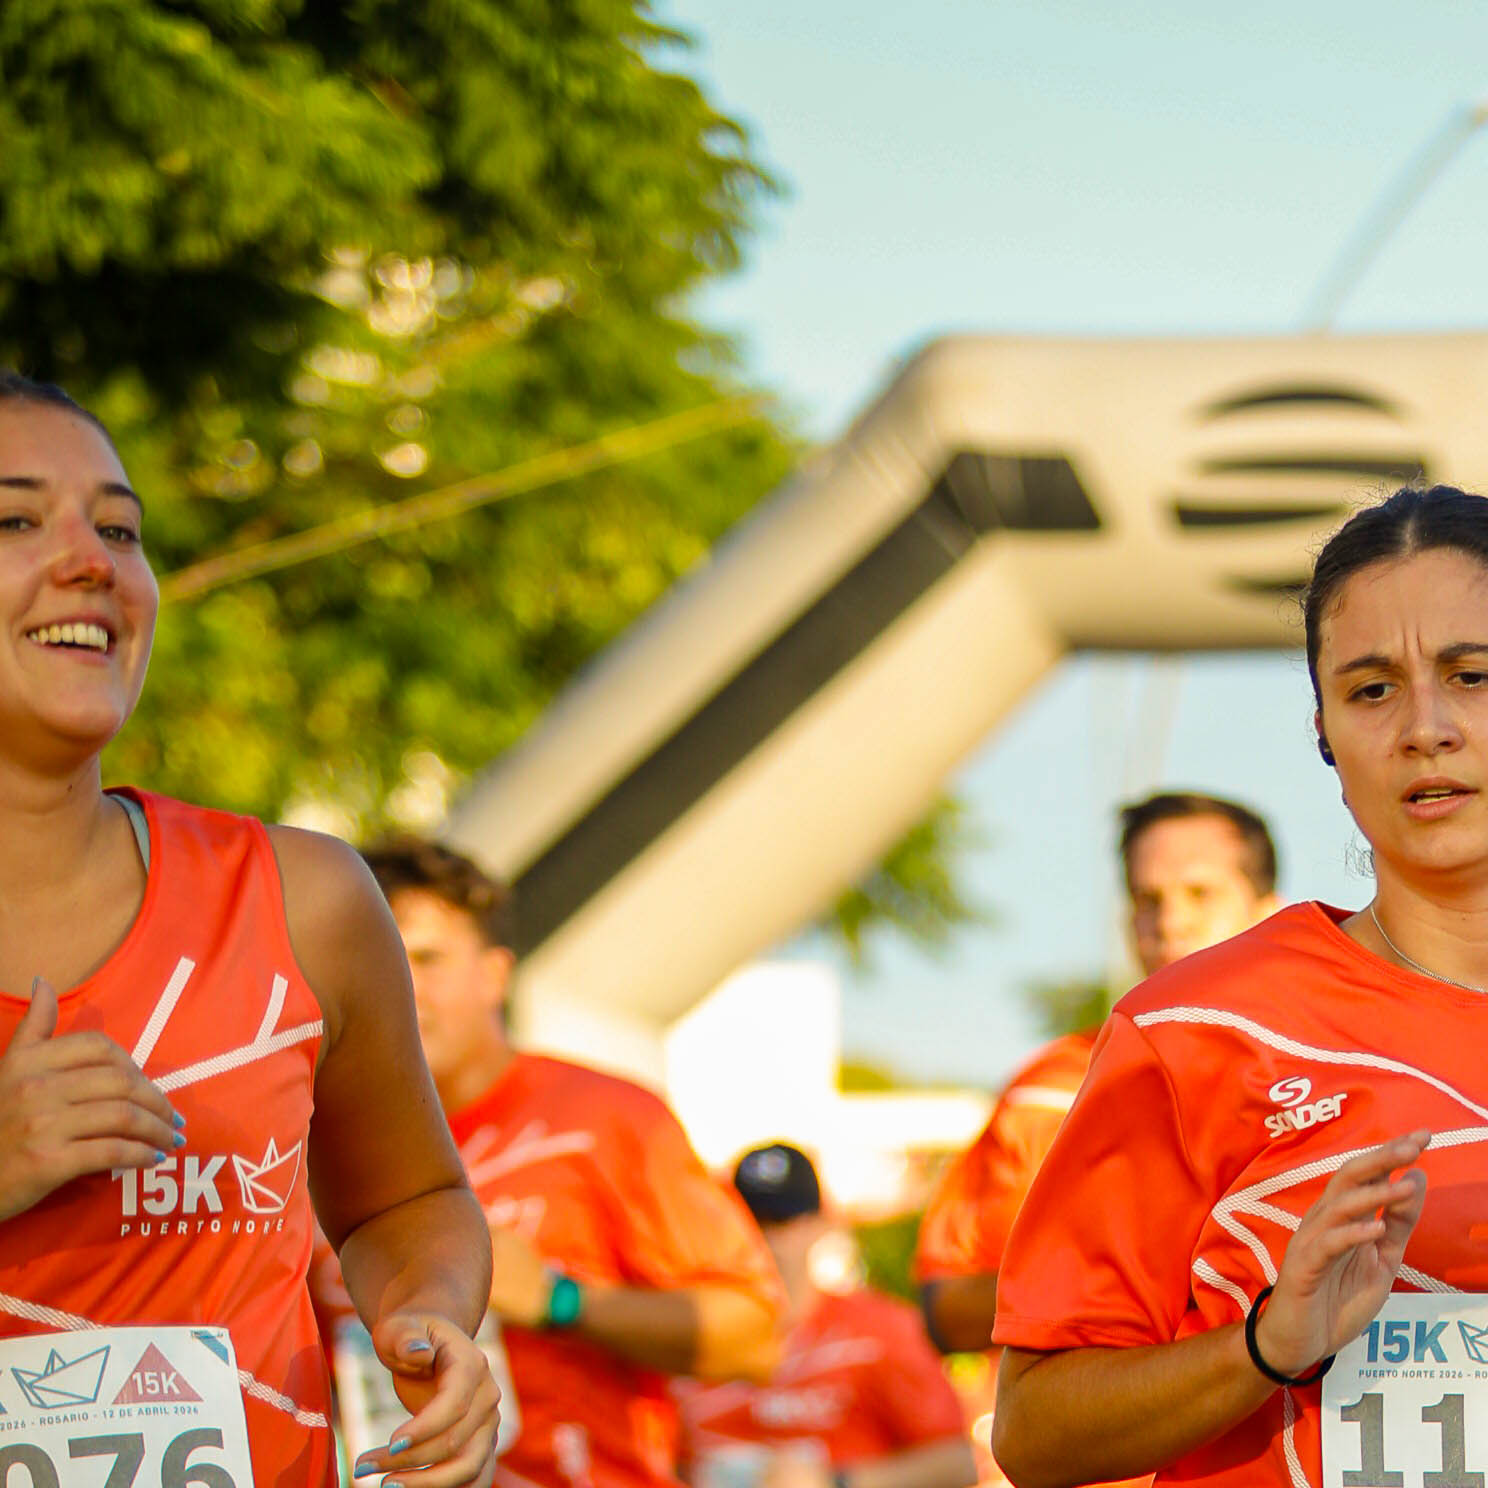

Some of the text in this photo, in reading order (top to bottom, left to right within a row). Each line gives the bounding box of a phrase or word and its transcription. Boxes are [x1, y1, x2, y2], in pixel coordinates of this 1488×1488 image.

[112, 1155, 227, 1216] 15K
[121, 1218, 283, 1237] PUERTO NORE
[1361, 1320, 1450, 1363] 15K
[132, 1371, 181, 1396] 15K
[1358, 1369, 1398, 1379] PUERTO
[1401, 1370, 1435, 1379] NORTE
[1439, 1371, 1463, 1380] 2026
[39, 1413, 89, 1426] ROSARIO
[103, 1410, 114, 1420] 12
[119, 1408, 133, 1418] DE
[138, 1407, 170, 1416] ABRIL
[174, 1405, 199, 1415] 2026
